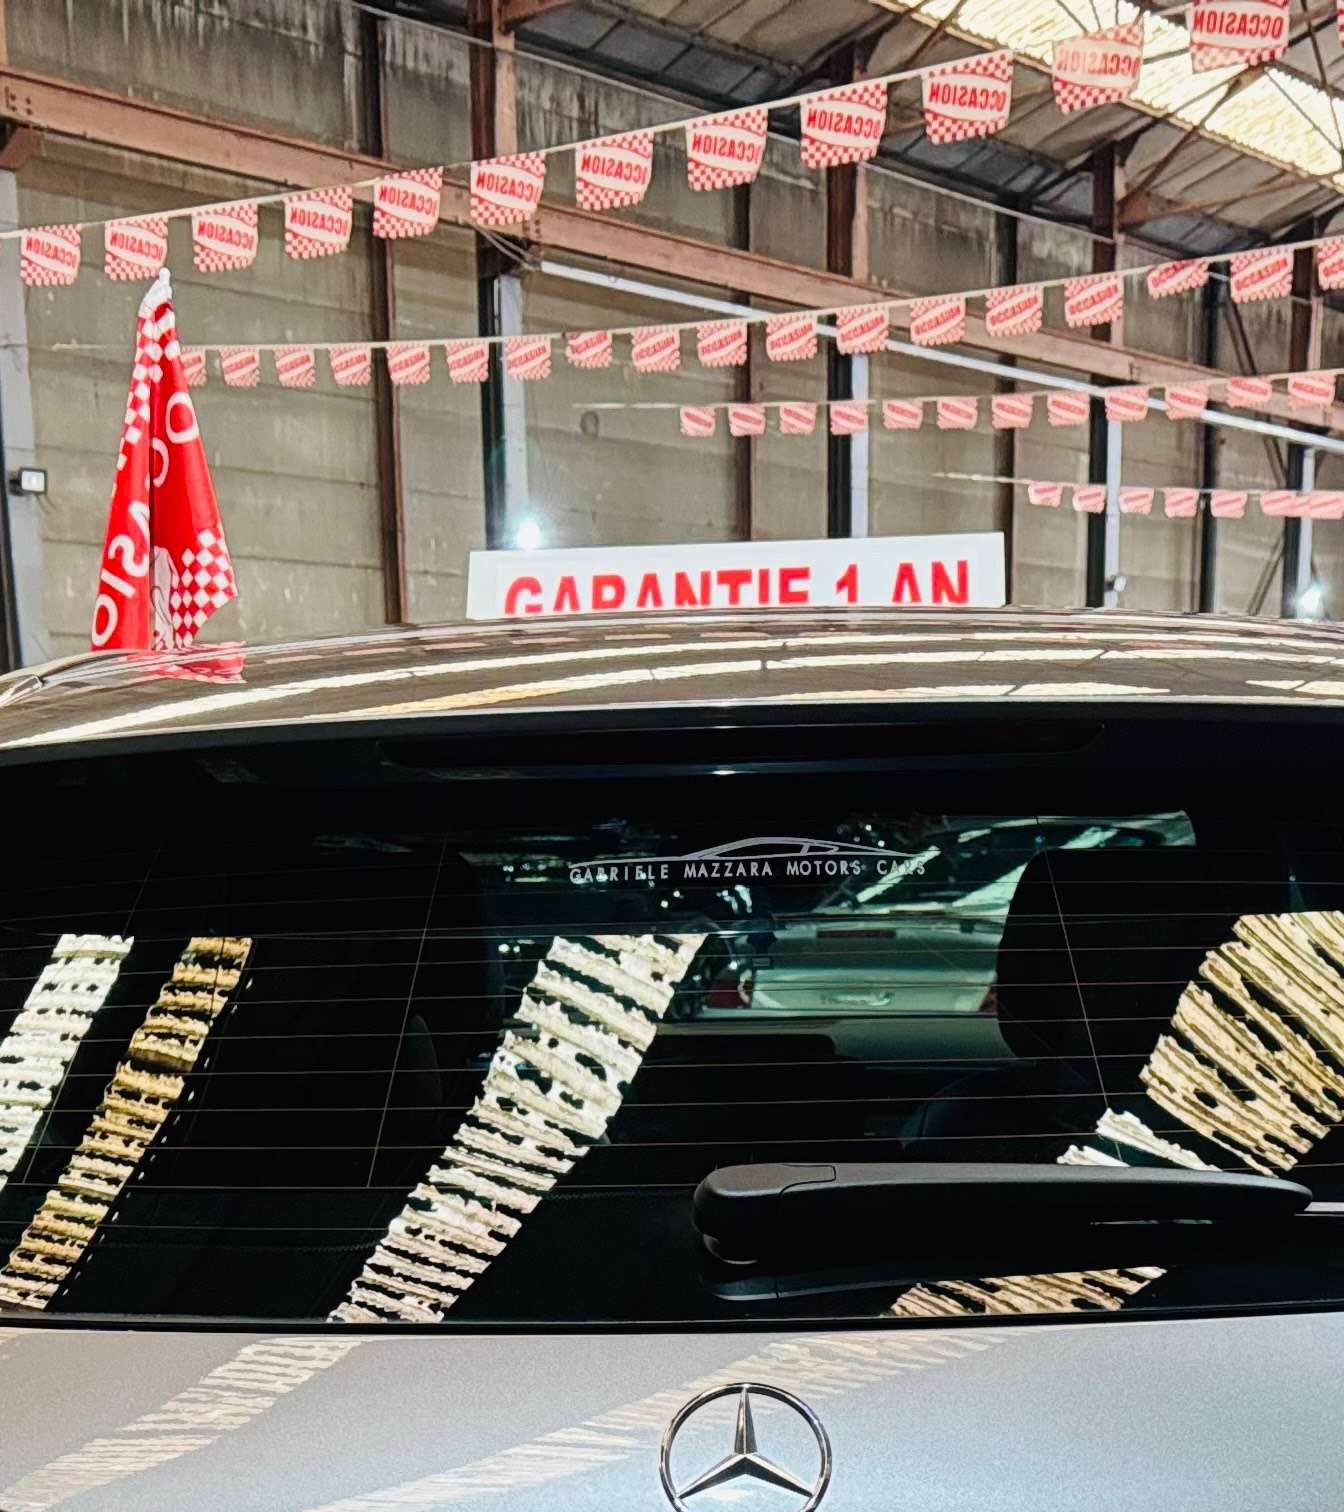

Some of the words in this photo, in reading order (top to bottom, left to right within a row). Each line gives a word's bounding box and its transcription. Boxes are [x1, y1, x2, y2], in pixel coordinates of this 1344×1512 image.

[504, 566, 811, 616] GARANTIE
[836, 563, 858, 605] 1
[891, 559, 970, 605] AN
[569, 863, 670, 885] GABRIELE
[683, 860, 773, 879] MAZZARA
[786, 859, 861, 877] MOTORS
[876, 859, 927, 877] CARS
